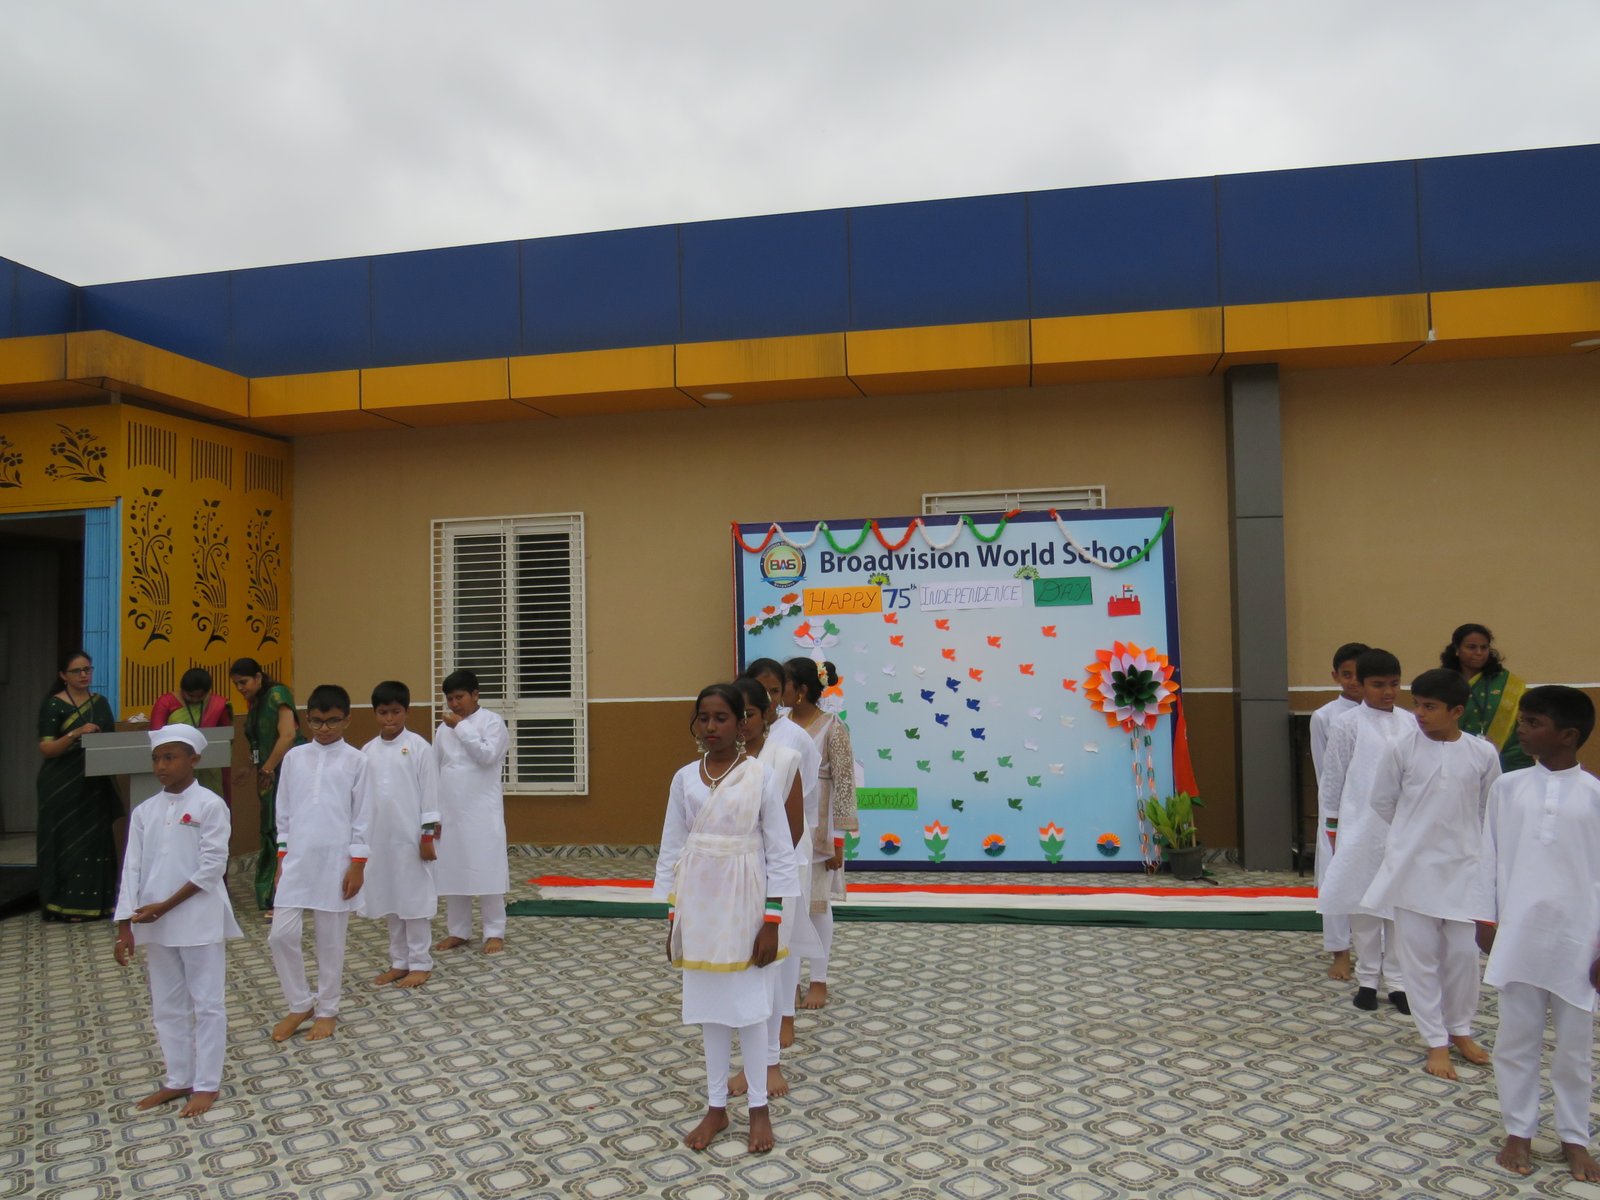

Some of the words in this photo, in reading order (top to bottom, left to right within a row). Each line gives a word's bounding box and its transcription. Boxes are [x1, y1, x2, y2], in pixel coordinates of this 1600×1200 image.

[820, 546, 970, 573] Broadvision
[976, 541, 1055, 567] World
[1063, 538, 1151, 565] School
[808, 591, 878, 612] HAPPY
[920, 584, 1021, 606] INDEPENDENCE
[1037, 580, 1088, 602] DAY
